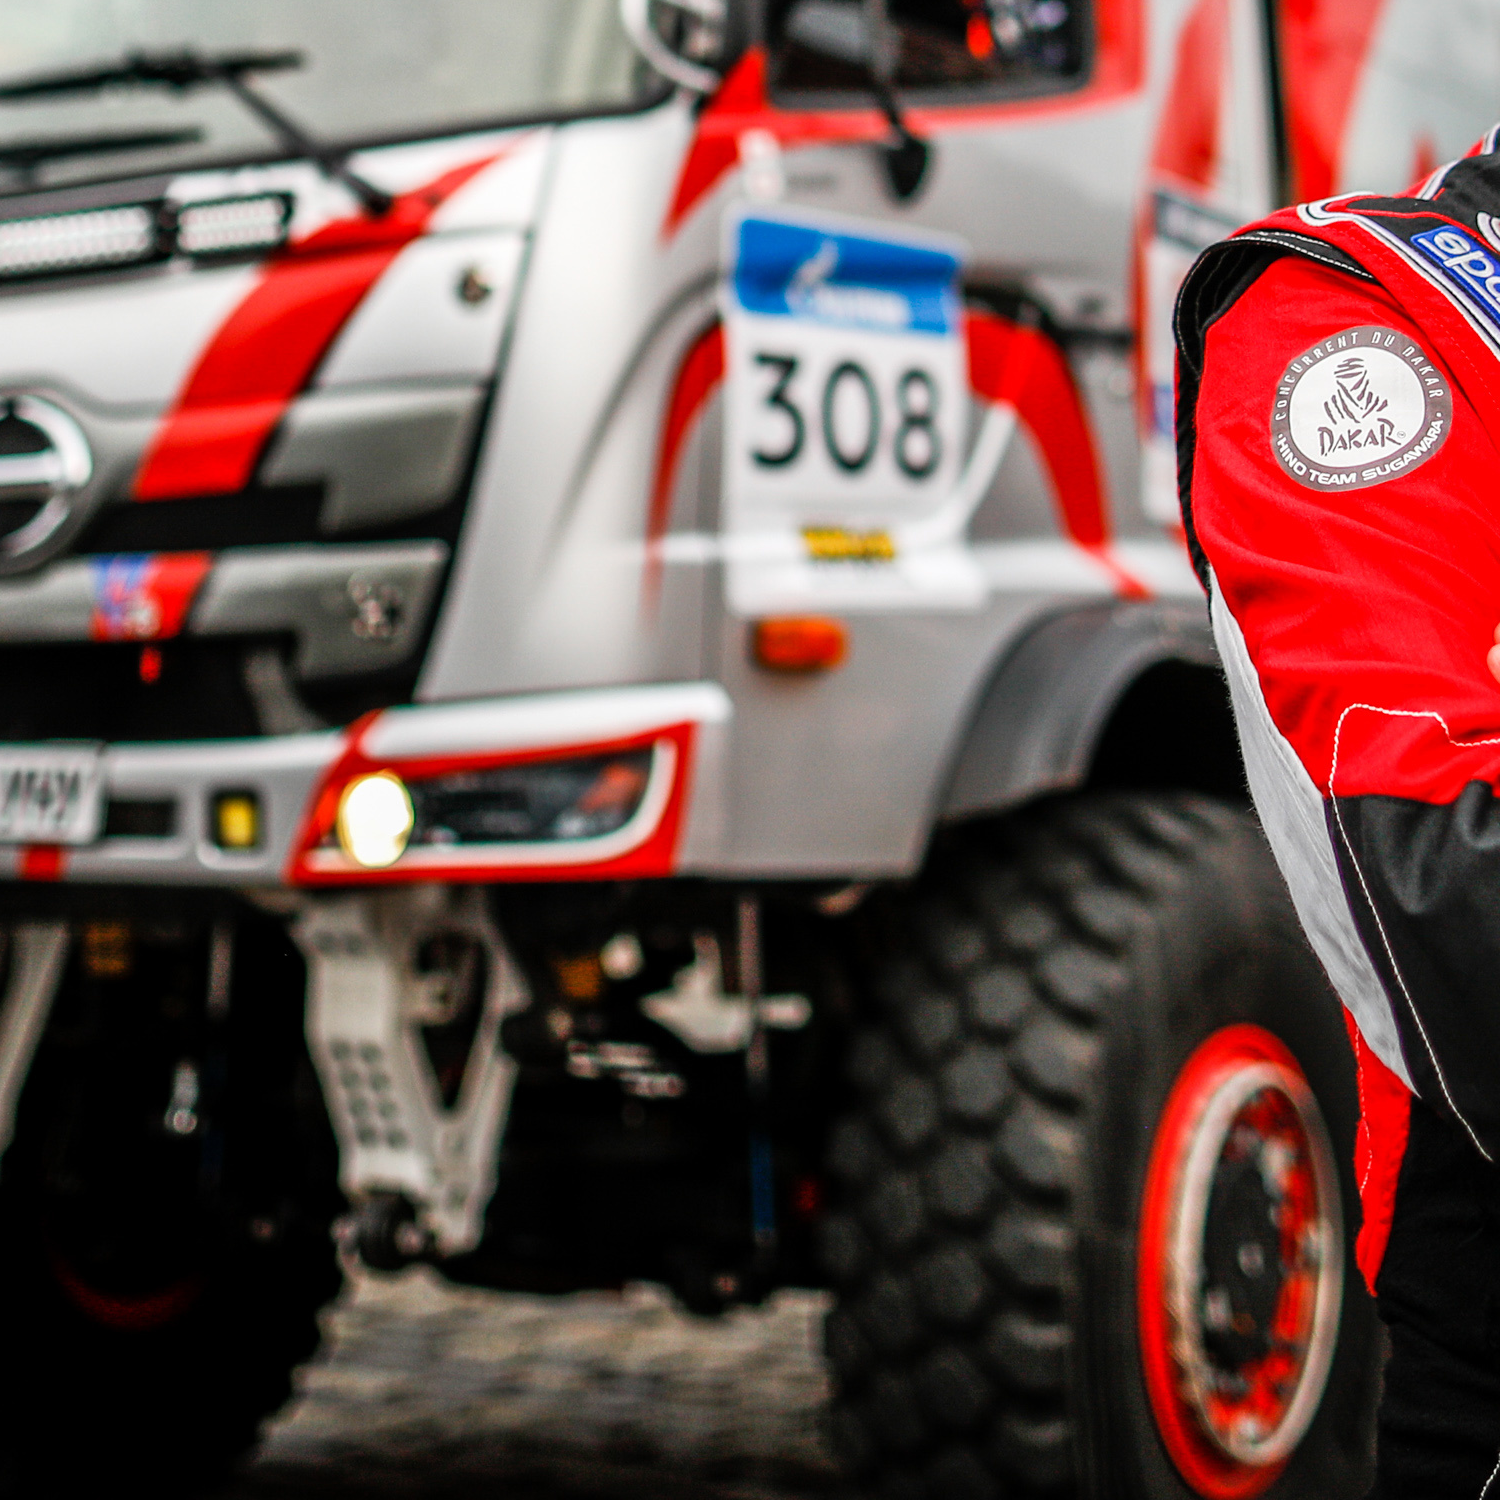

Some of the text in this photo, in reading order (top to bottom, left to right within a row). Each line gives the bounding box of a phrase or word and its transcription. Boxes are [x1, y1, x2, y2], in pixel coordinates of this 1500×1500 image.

[1274, 330, 1445, 422] CONCURRENT DU DAKAR
[750, 348, 941, 484] 308
[1276, 419, 1444, 486] HINO TEAM SUGAWARA
[1317, 417, 1402, 457] DAKAR
